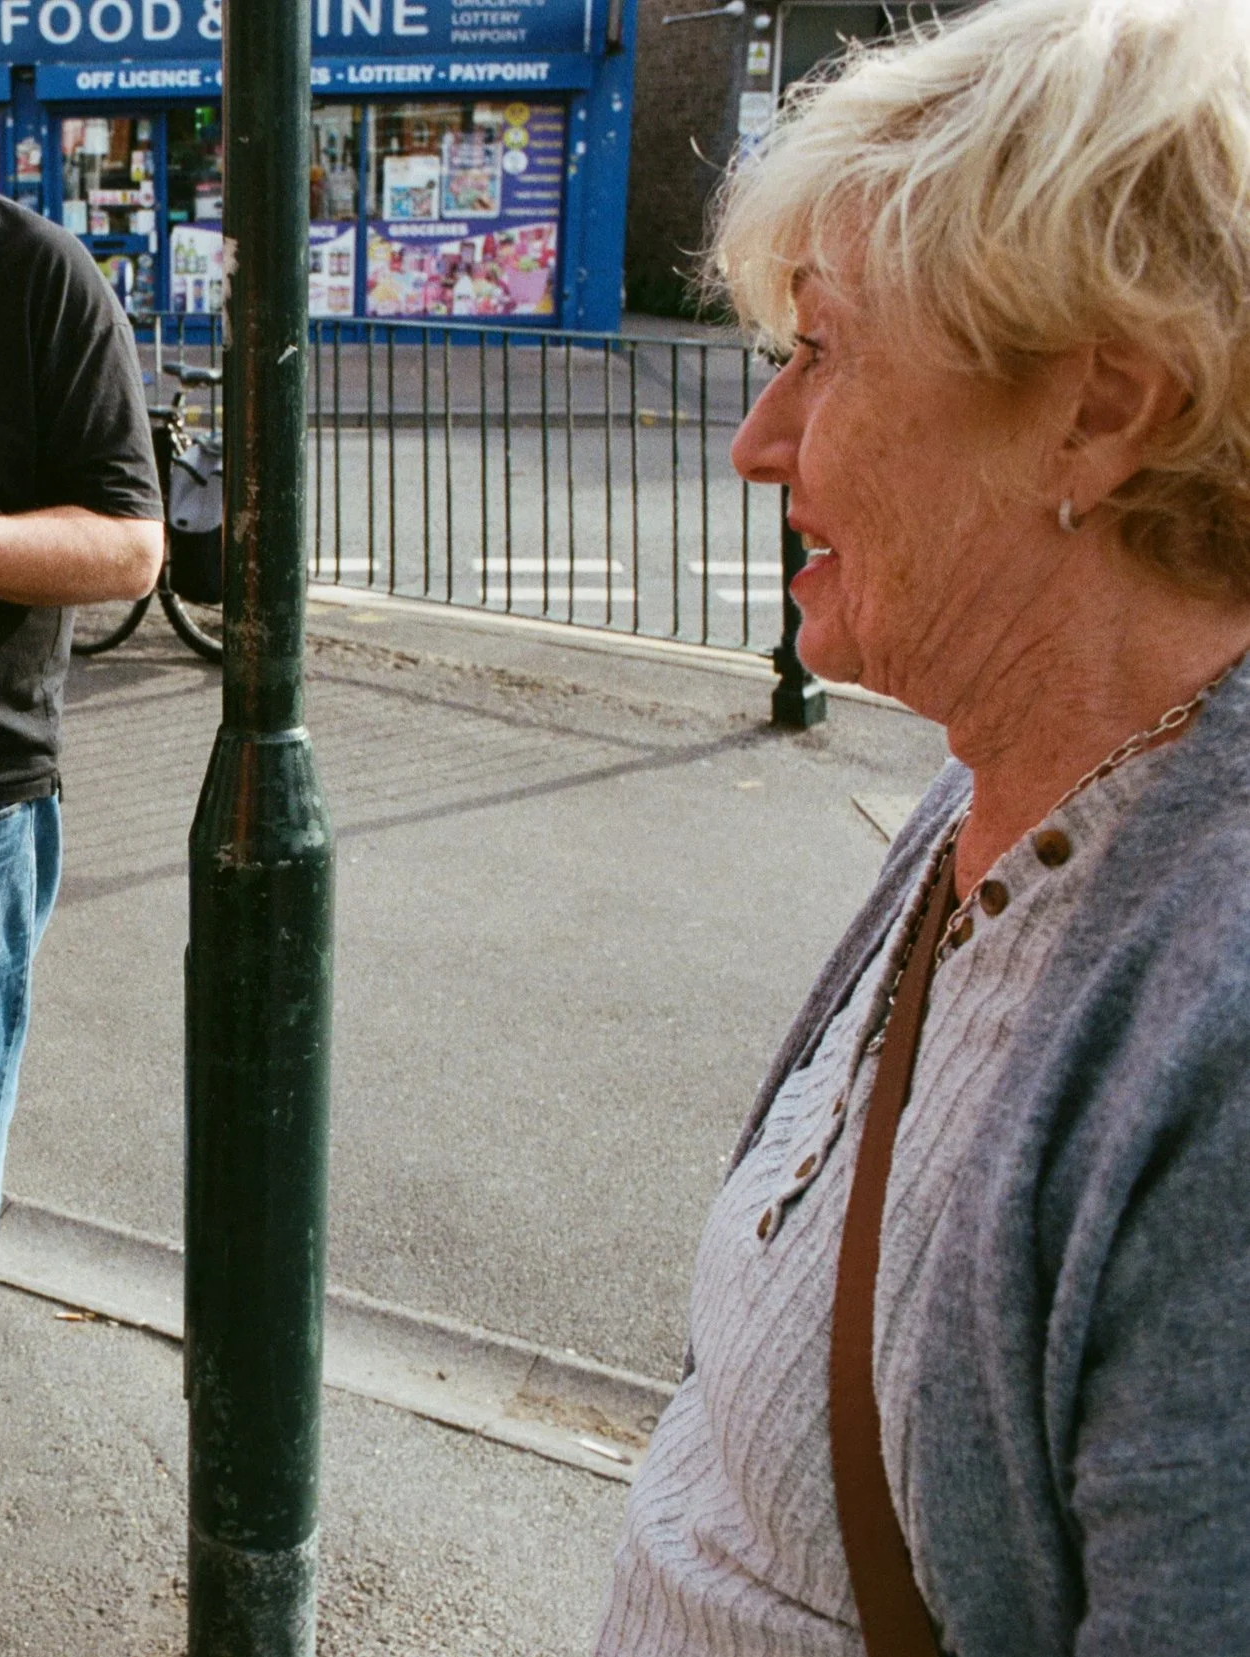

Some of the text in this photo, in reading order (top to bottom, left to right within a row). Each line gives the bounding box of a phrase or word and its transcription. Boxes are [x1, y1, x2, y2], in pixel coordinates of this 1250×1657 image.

[1, 0, 181, 45] FOOD
[316, 0, 429, 37] INE
[450, 10, 520, 26] LOTTERY
[450, 28, 527, 43] PAYPOINT
[76, 70, 113, 89] OFF
[118, 69, 201, 88] LICENCE
[347, 64, 435, 84] LOTTERY
[449, 62, 550, 83] PAYPOINT
